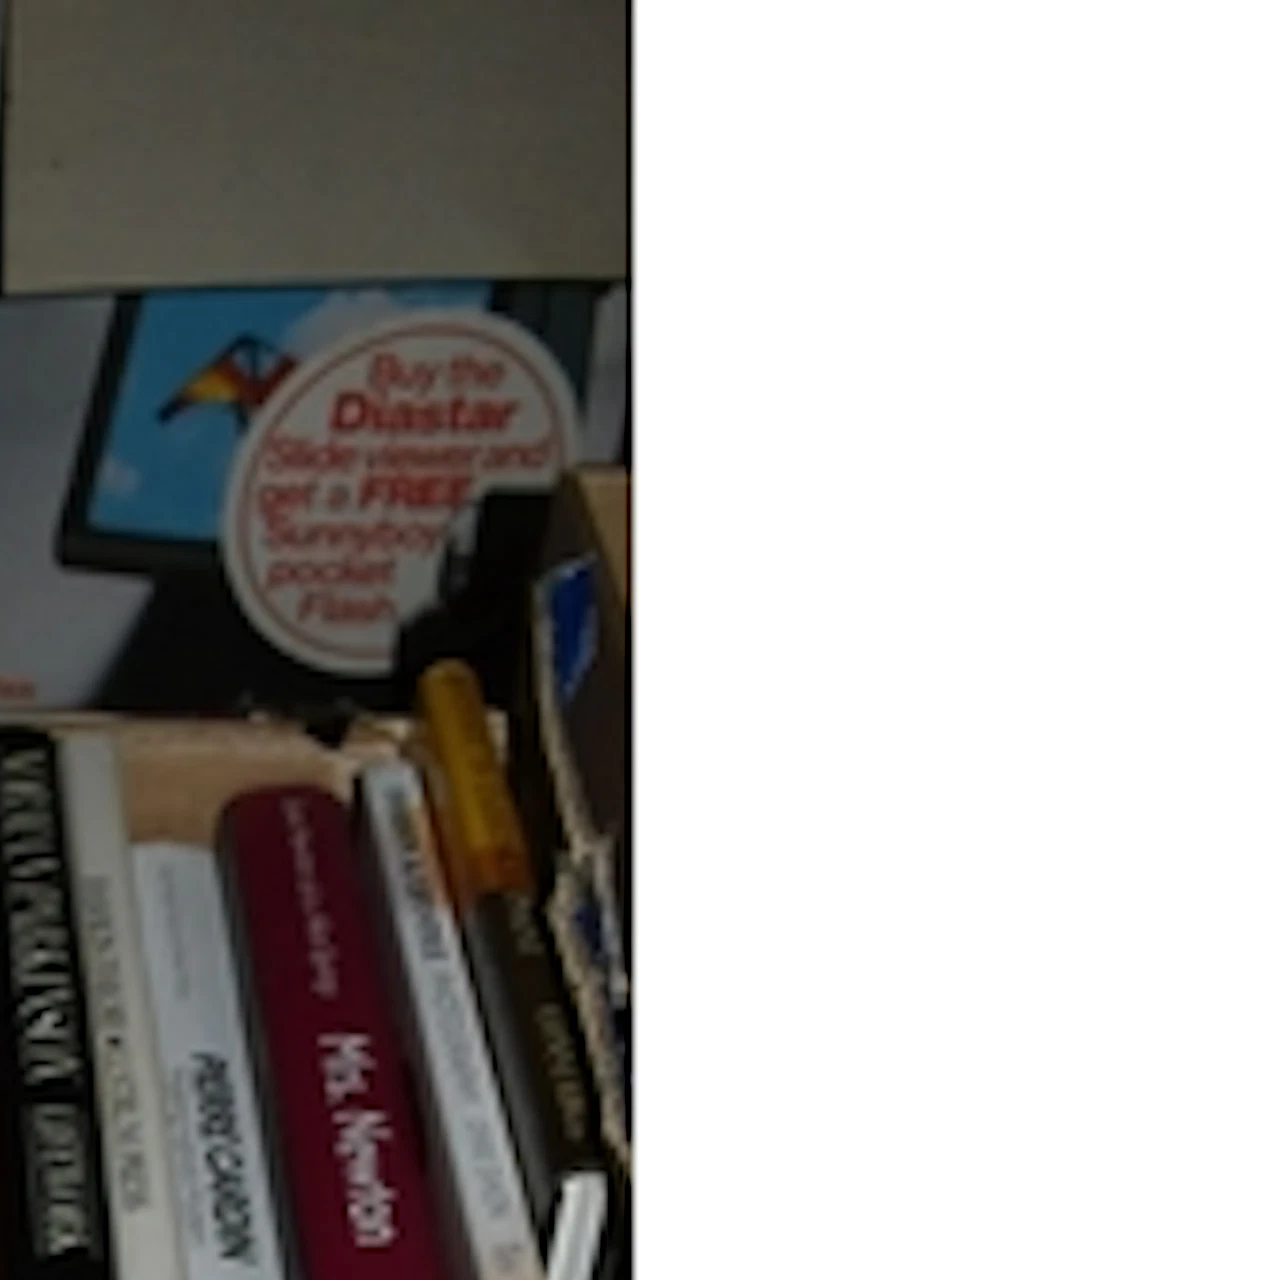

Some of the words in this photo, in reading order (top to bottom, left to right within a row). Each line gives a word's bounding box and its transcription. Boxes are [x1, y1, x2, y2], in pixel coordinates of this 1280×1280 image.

[369, 353, 436, 391] Buy
[448, 353, 506, 385] the
[330, 393, 516, 432] Diastar
[481, 444, 550, 470] and
[358, 474, 476, 508] FREE
[294, 592, 397, 625] Flash
[316, 1031, 376, 1106] Mrs.
[334, 1108, 401, 1252] Newton
